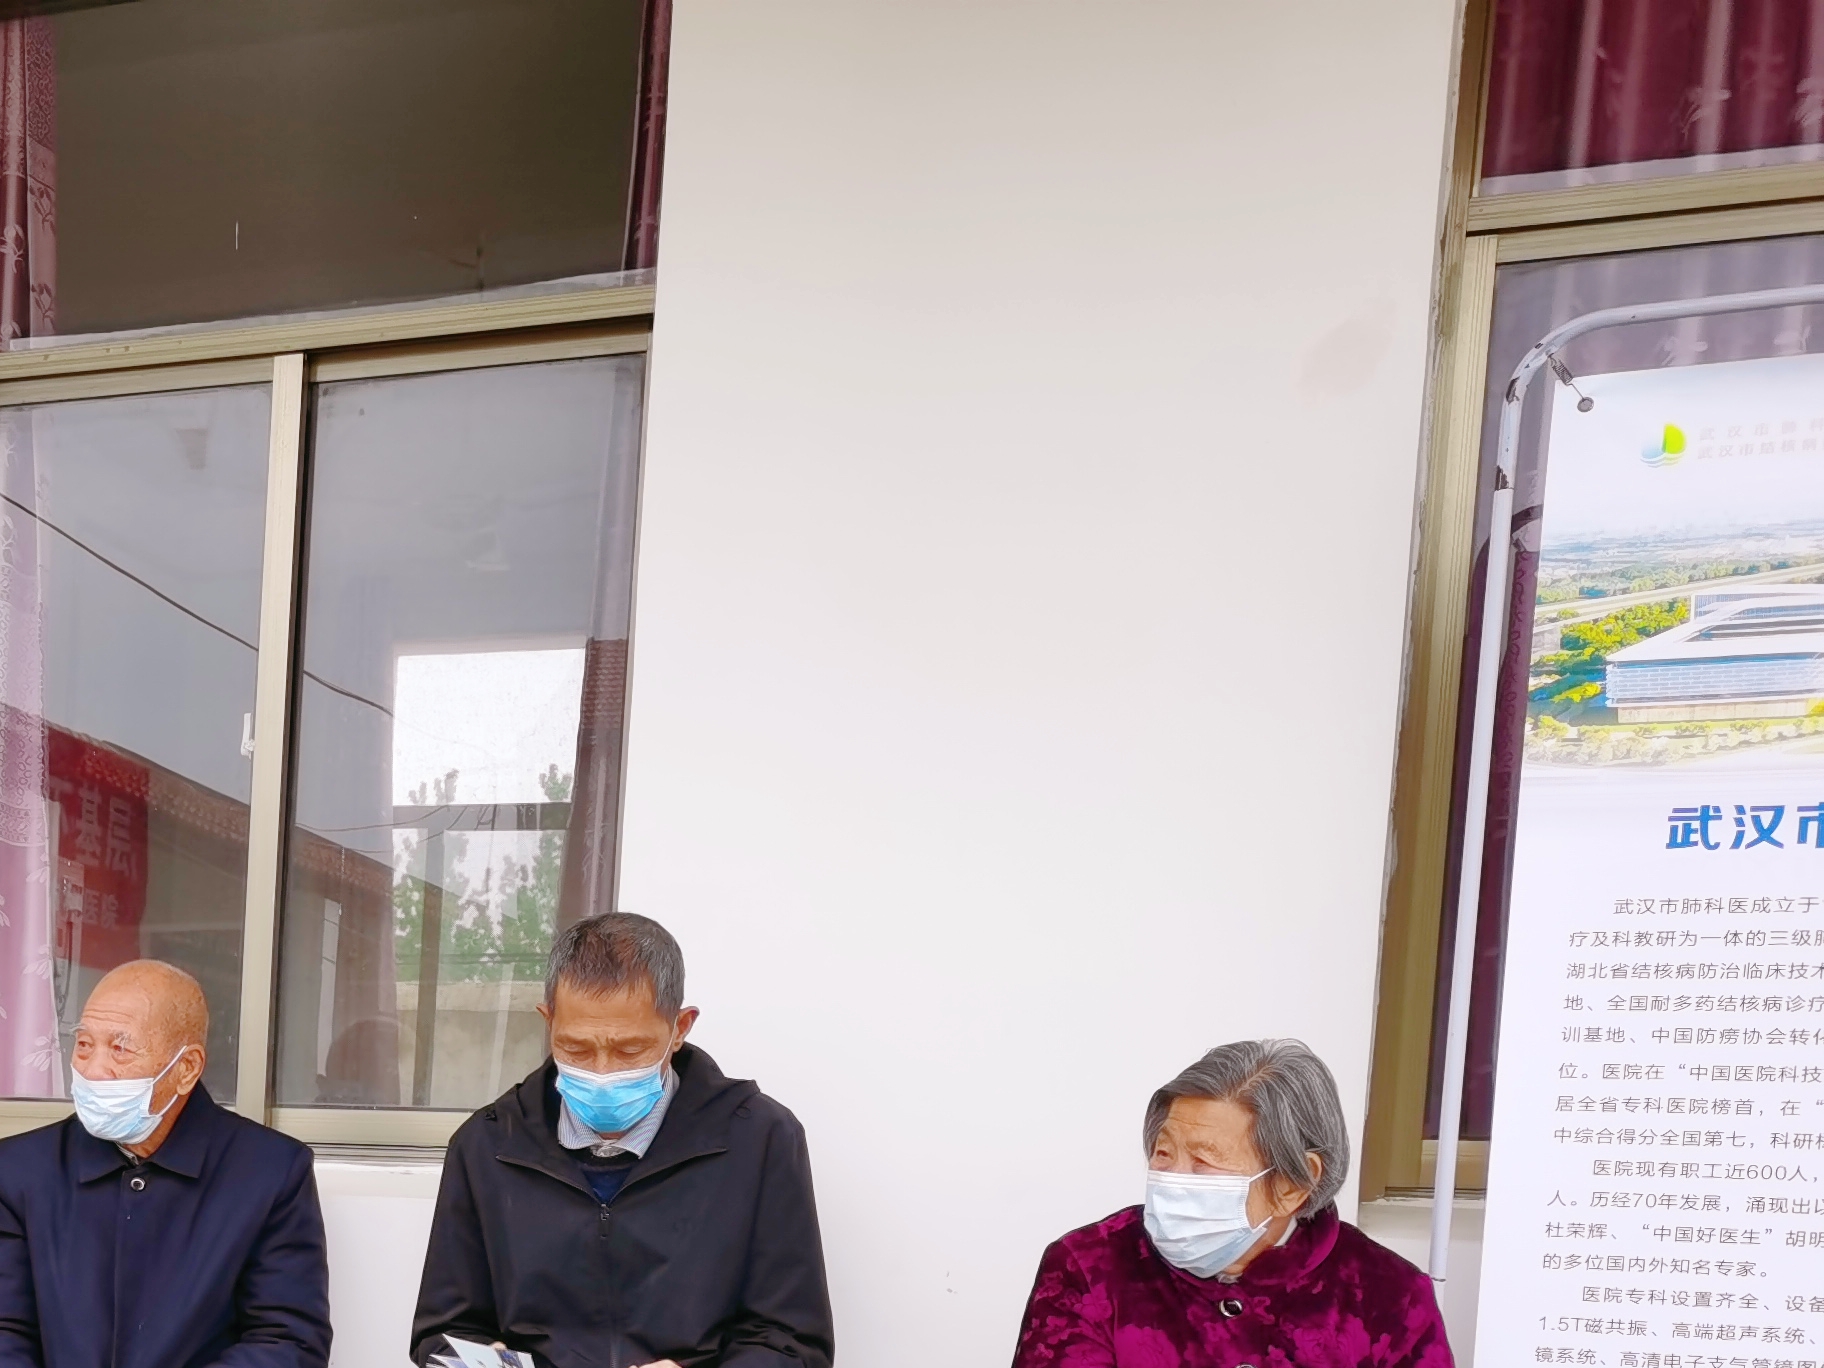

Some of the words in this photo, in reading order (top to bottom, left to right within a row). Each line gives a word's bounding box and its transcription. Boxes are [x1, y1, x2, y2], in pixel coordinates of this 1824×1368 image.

[1543, 1253, 1766, 1277] 的多位国内外知名专家。
